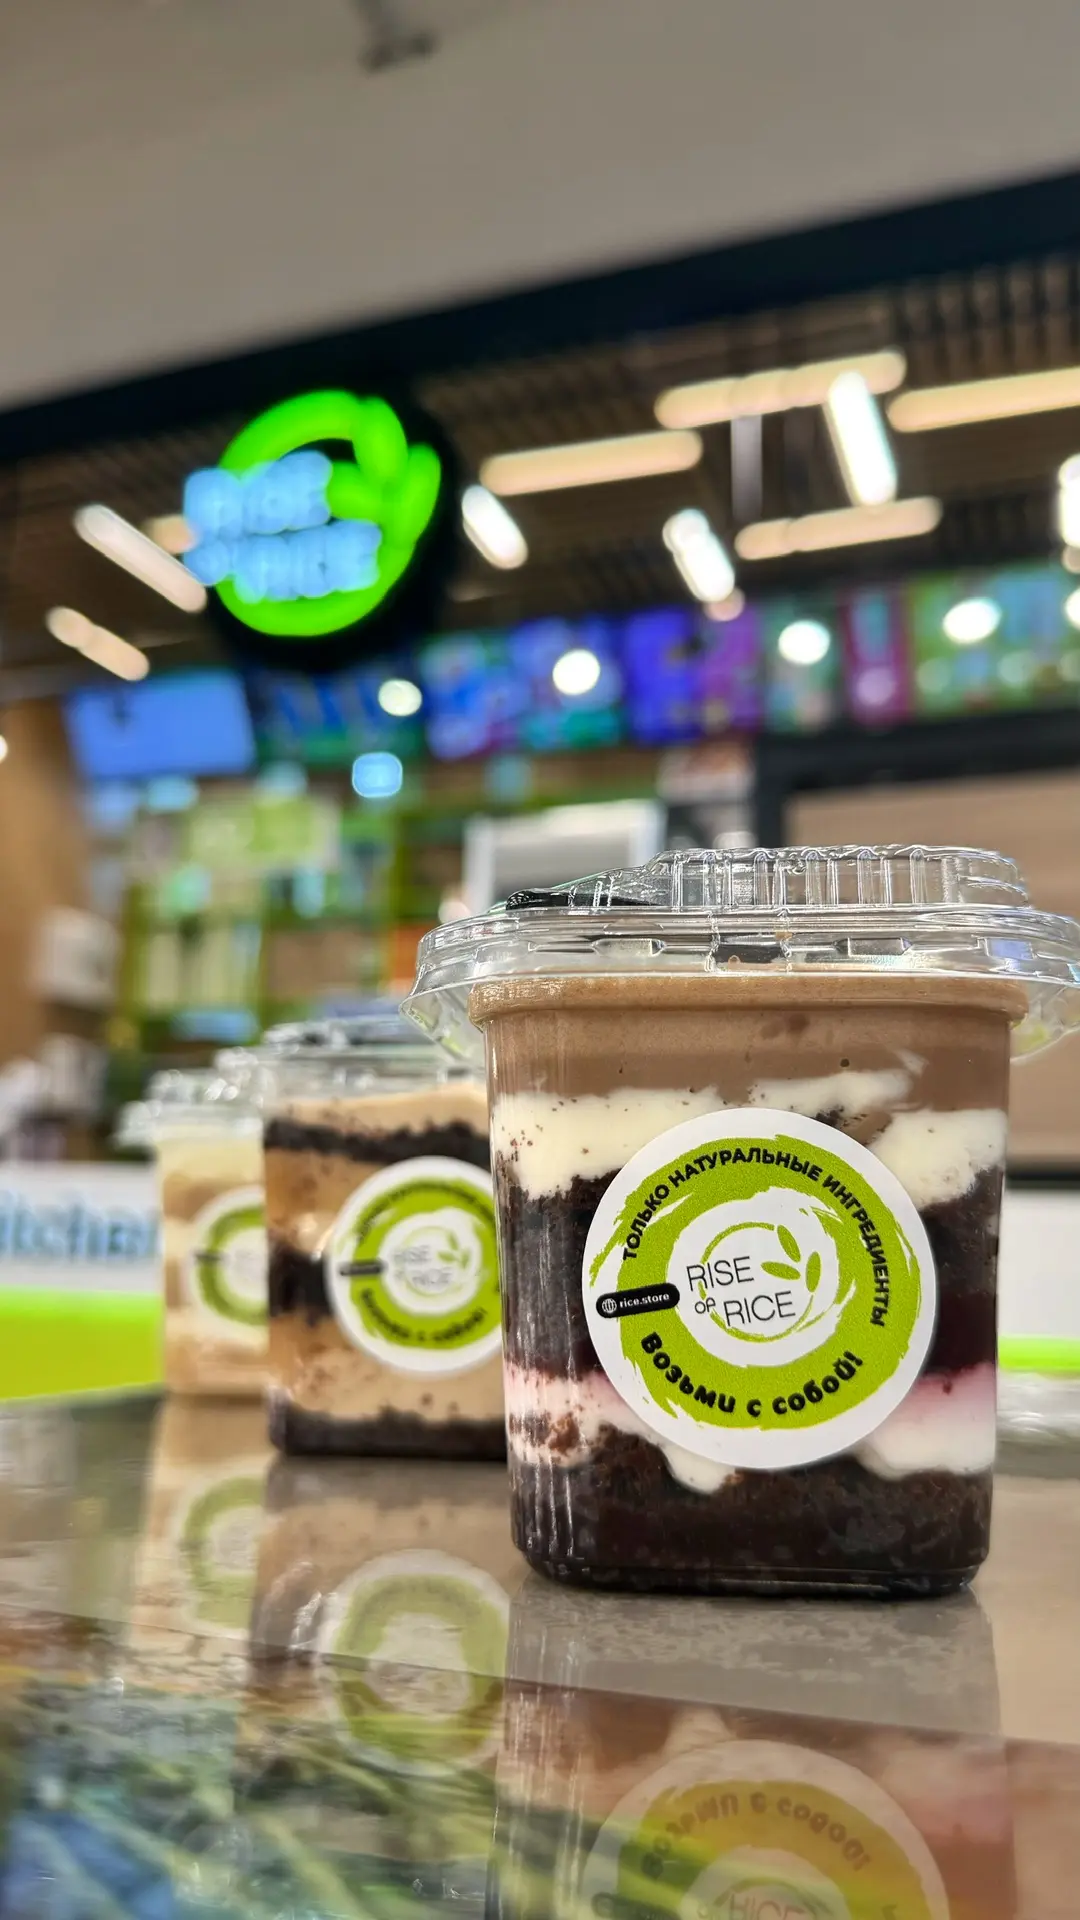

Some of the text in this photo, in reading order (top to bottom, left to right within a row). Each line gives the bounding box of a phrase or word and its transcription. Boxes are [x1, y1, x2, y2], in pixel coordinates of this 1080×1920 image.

[622, 1147, 890, 1327] ТОЛЬКО НАТУРАЛЬНЫЕ ИНГРЕДИЕНТЫ
[686, 1256, 754, 1292] RISE
[620, 1293, 670, 1308] rice.store
[723, 1290, 796, 1327] RICE
[641, 1331, 737, 1414] Возьми
[772, 1350, 863, 1415] собой!
